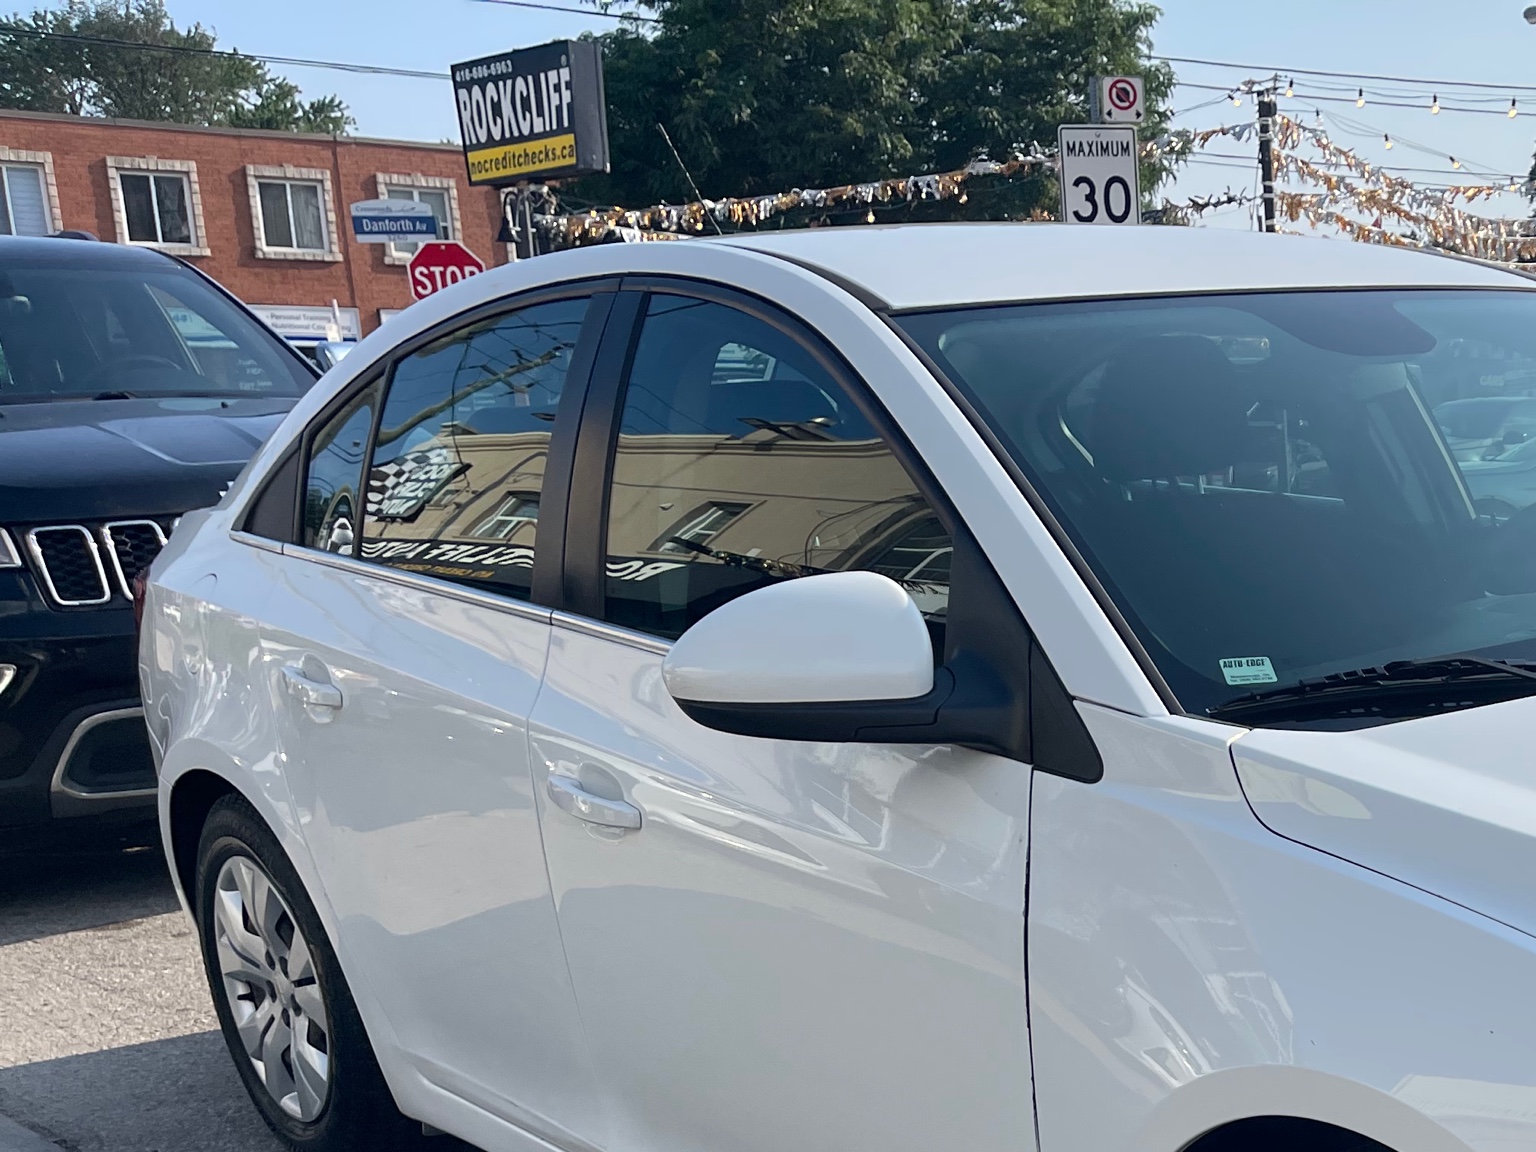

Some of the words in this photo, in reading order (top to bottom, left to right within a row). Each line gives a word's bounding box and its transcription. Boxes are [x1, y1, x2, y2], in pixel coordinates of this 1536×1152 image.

[457, 67, 572, 146] ROCKCLIFF
[470, 142, 575, 175] nocreditchecks.ca
[1066, 140, 1131, 157] MAXIMUM
[1072, 175, 1132, 224] 30
[362, 218, 414, 232] Danforth
